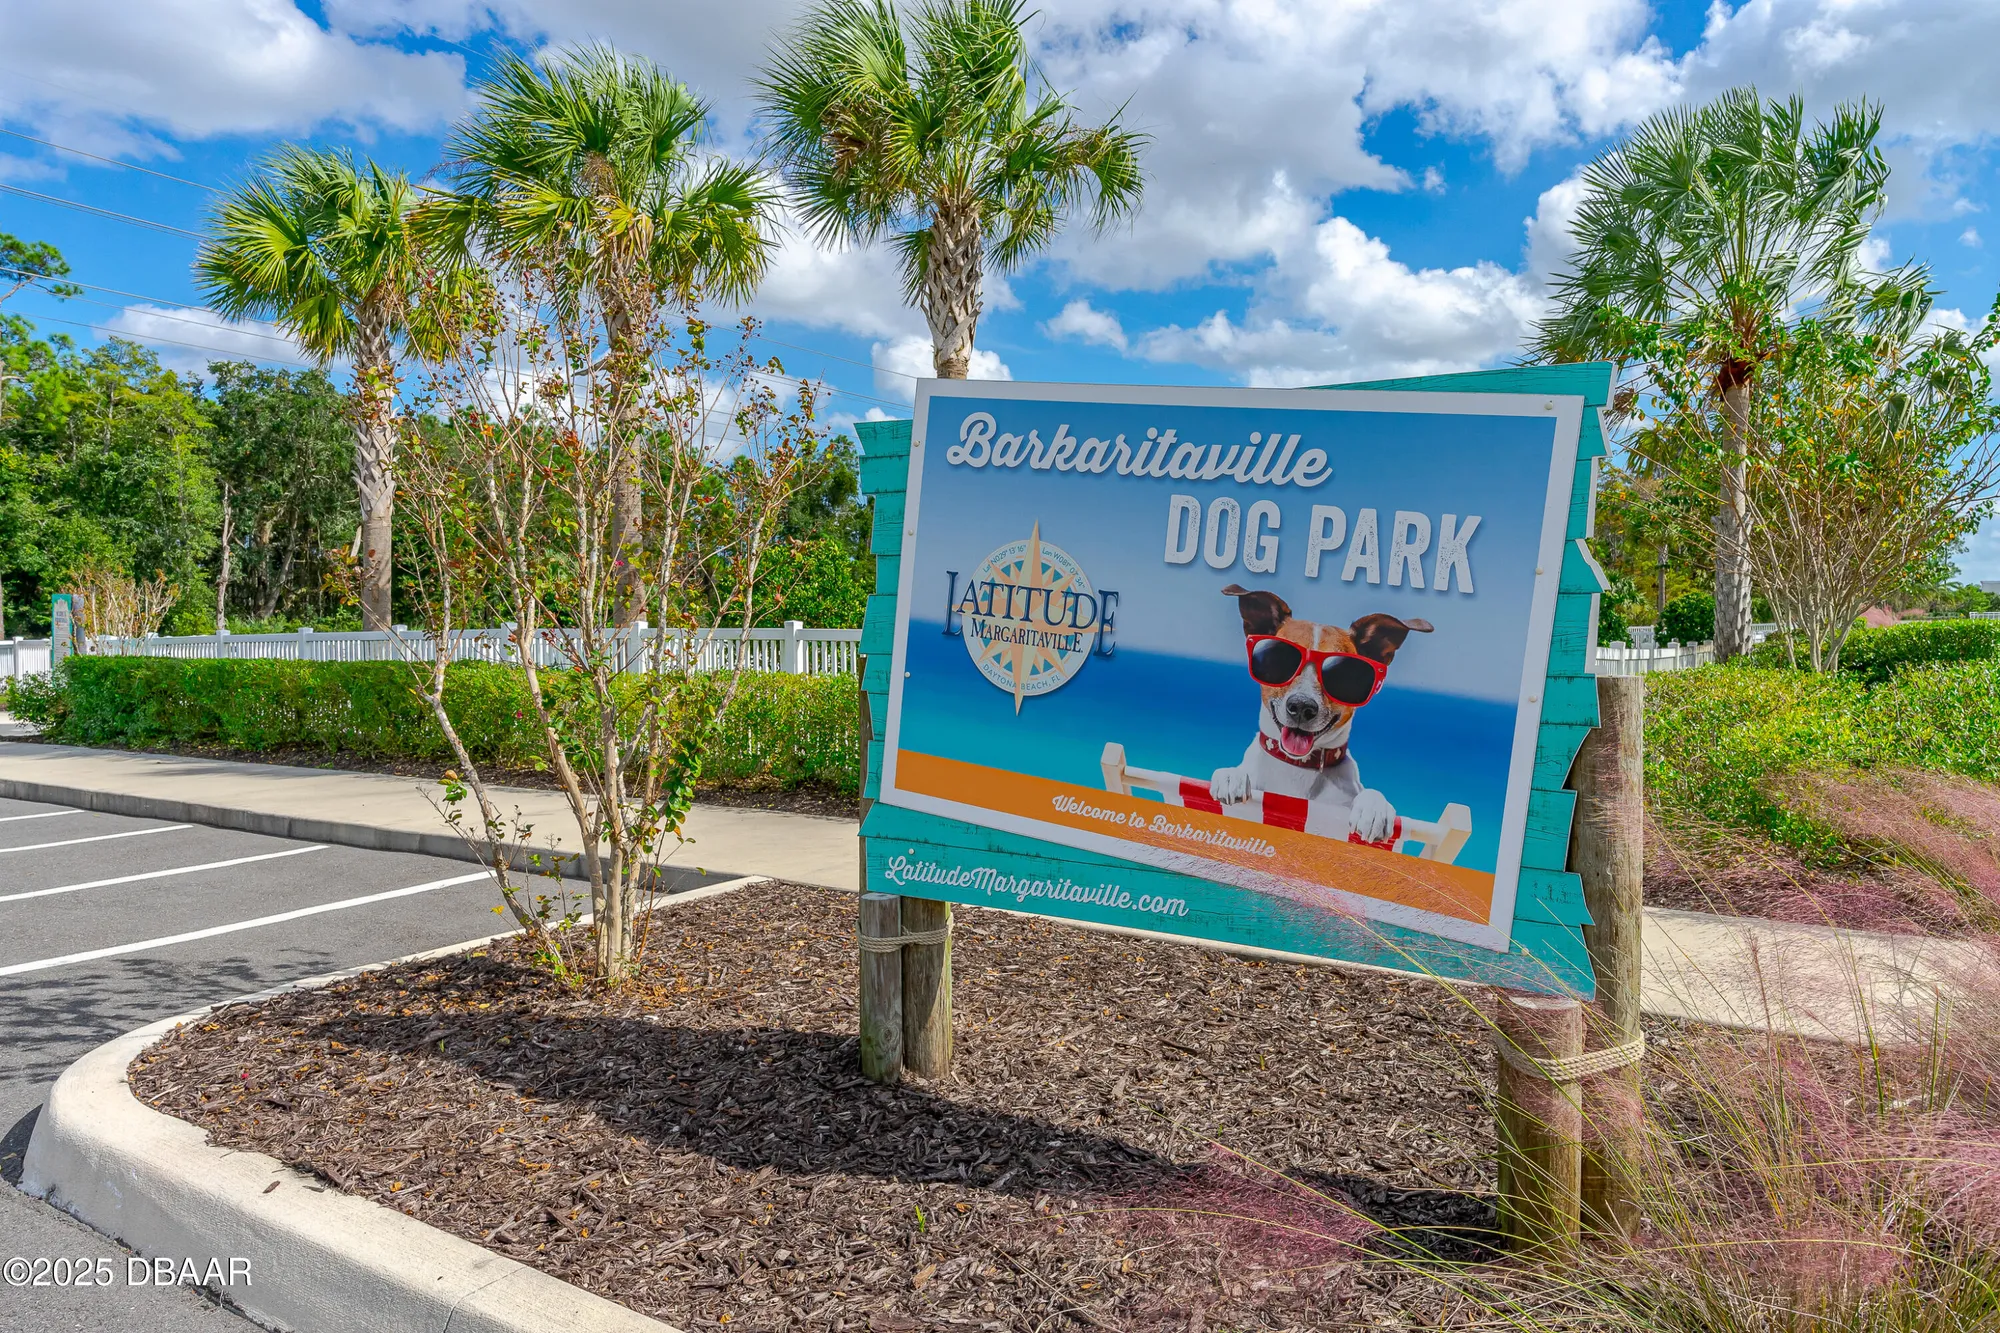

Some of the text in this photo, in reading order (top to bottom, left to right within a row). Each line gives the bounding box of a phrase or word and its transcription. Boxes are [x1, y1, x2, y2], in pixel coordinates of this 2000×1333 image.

[946, 411, 1333, 488] Barkaritaville
[1042, 547, 1053, 557] Lon
[1164, 494, 1481, 593] DOG PARK
[941, 570, 1119, 658] LATITUDE
[970, 618, 1084, 654] MARGARITAVILLE
[983, 663, 1061, 691] DAYTONA BEACH, FL
[1052, 795, 1276, 859] Welcome to Barkaritaville
[885, 855, 1190, 918] LatitudeMargaritaville.com
